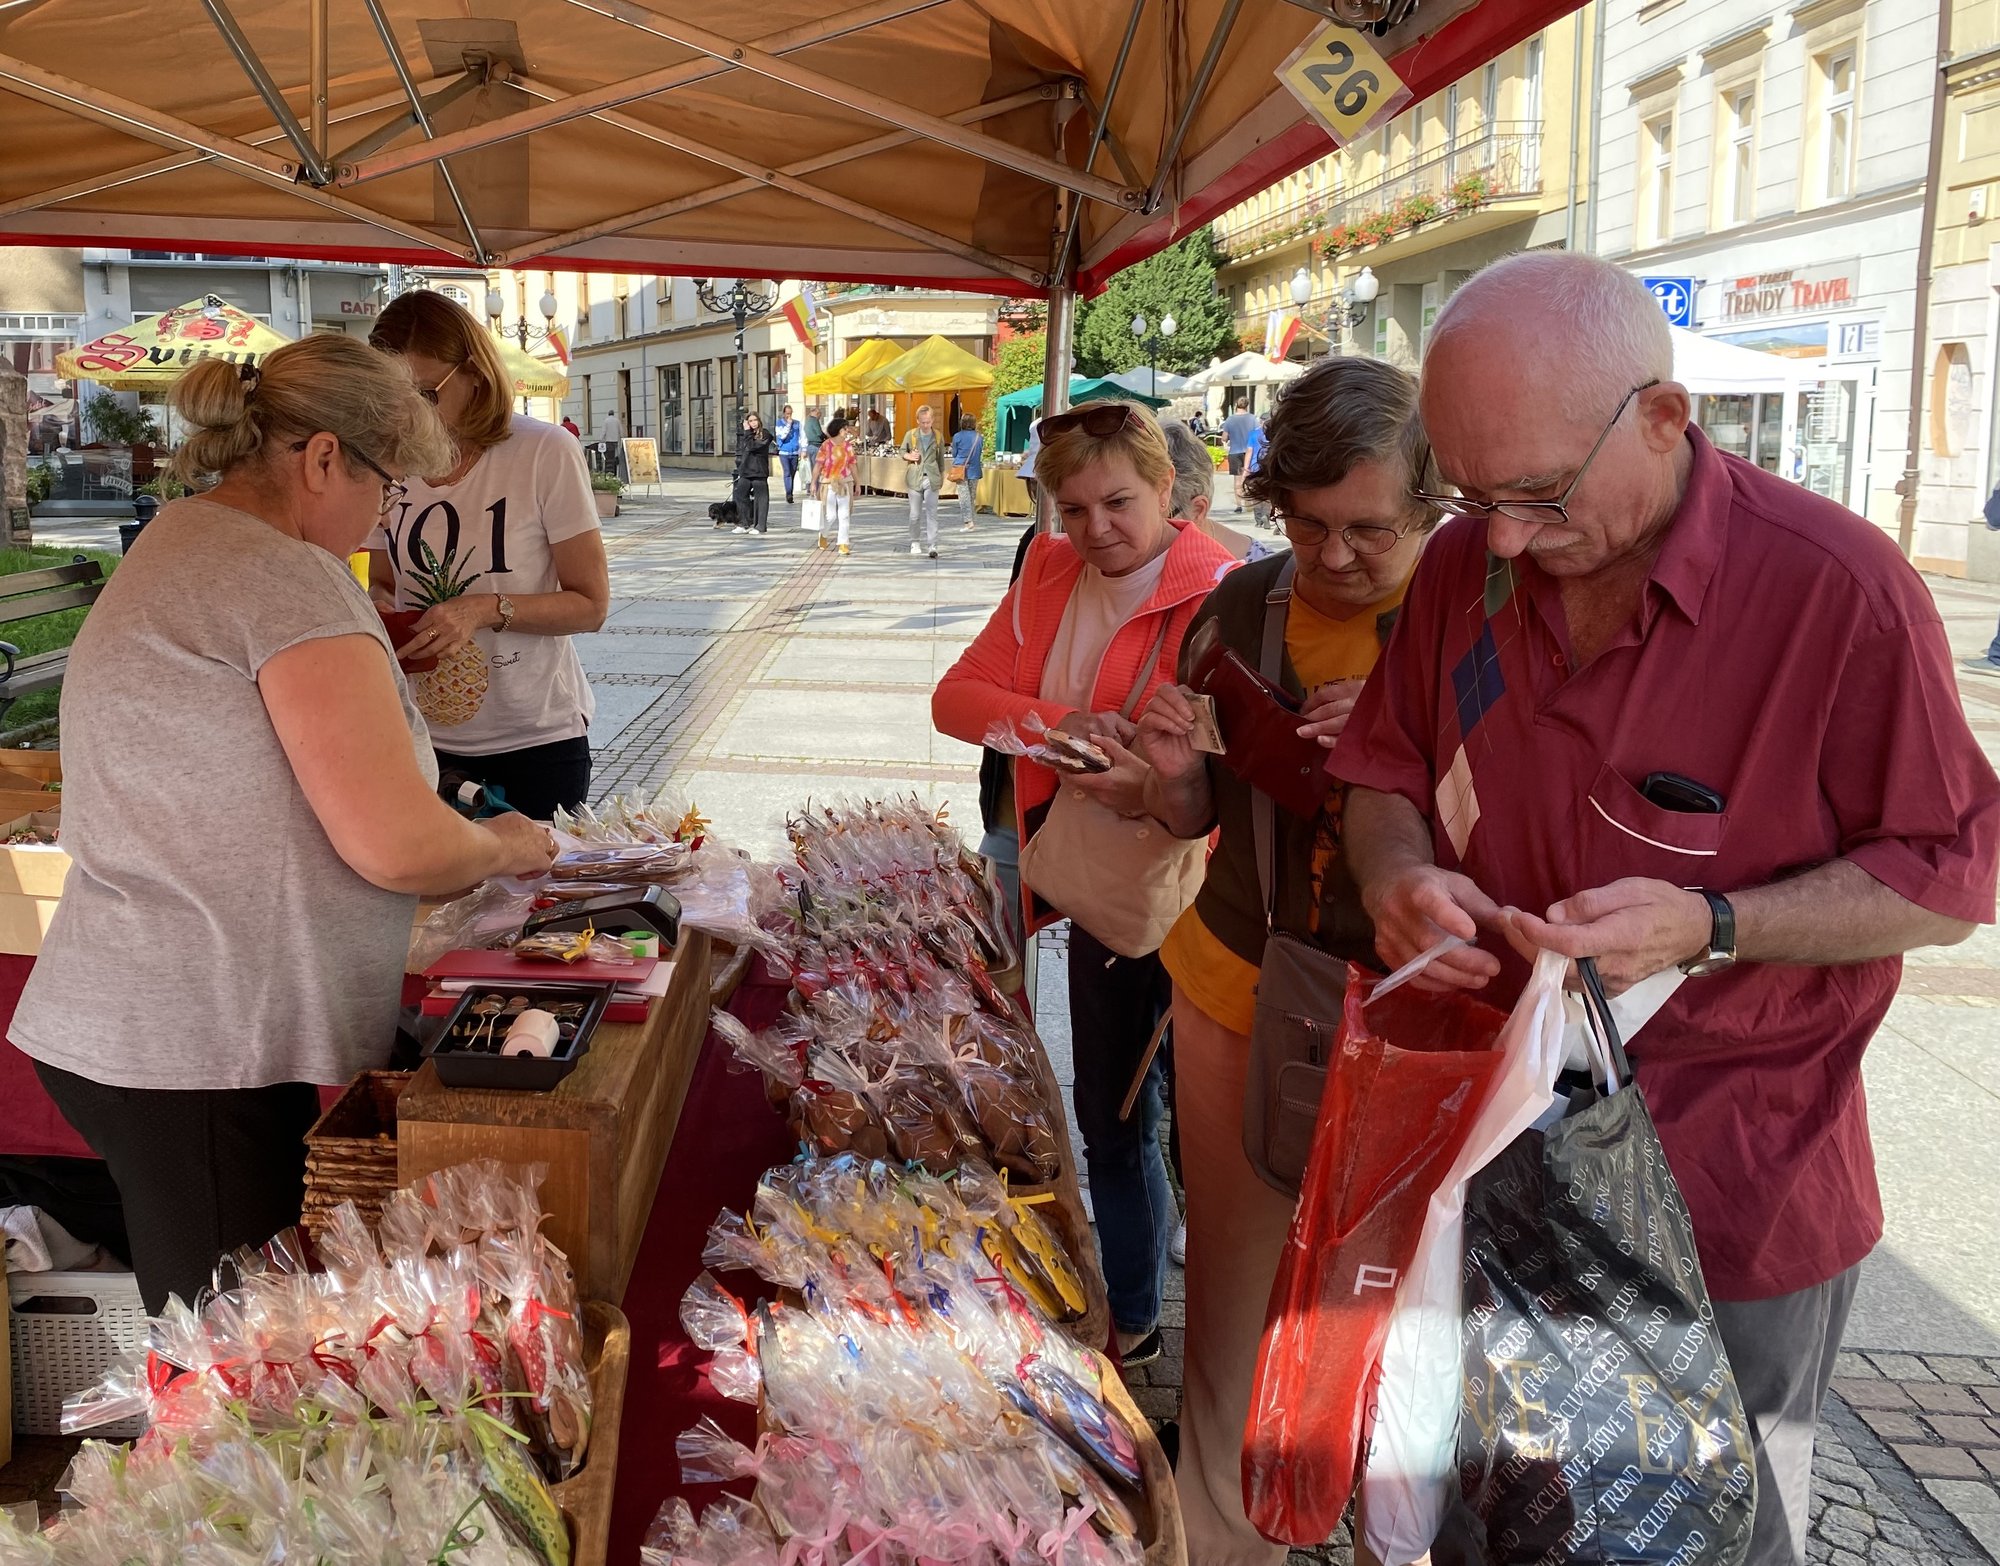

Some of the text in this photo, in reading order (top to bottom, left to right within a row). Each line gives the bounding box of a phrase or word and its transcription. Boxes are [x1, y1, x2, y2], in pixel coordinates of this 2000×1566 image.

[1302, 41, 1379, 116] 26
[340, 301, 377, 316] CAFE
[1725, 287, 1785, 316] TRENDY
[1790, 277, 1850, 306] TRAVEL
[491, 651, 521, 669] Sweet
[1631, 1305, 1672, 1354] TREND
[1521, 1352, 1562, 1399] TREND
[1523, 1453, 1591, 1526] EXCLUSIVE
[1598, 1464, 1644, 1514] TREND
[1624, 1480, 1690, 1554] EXCLUSIVE
